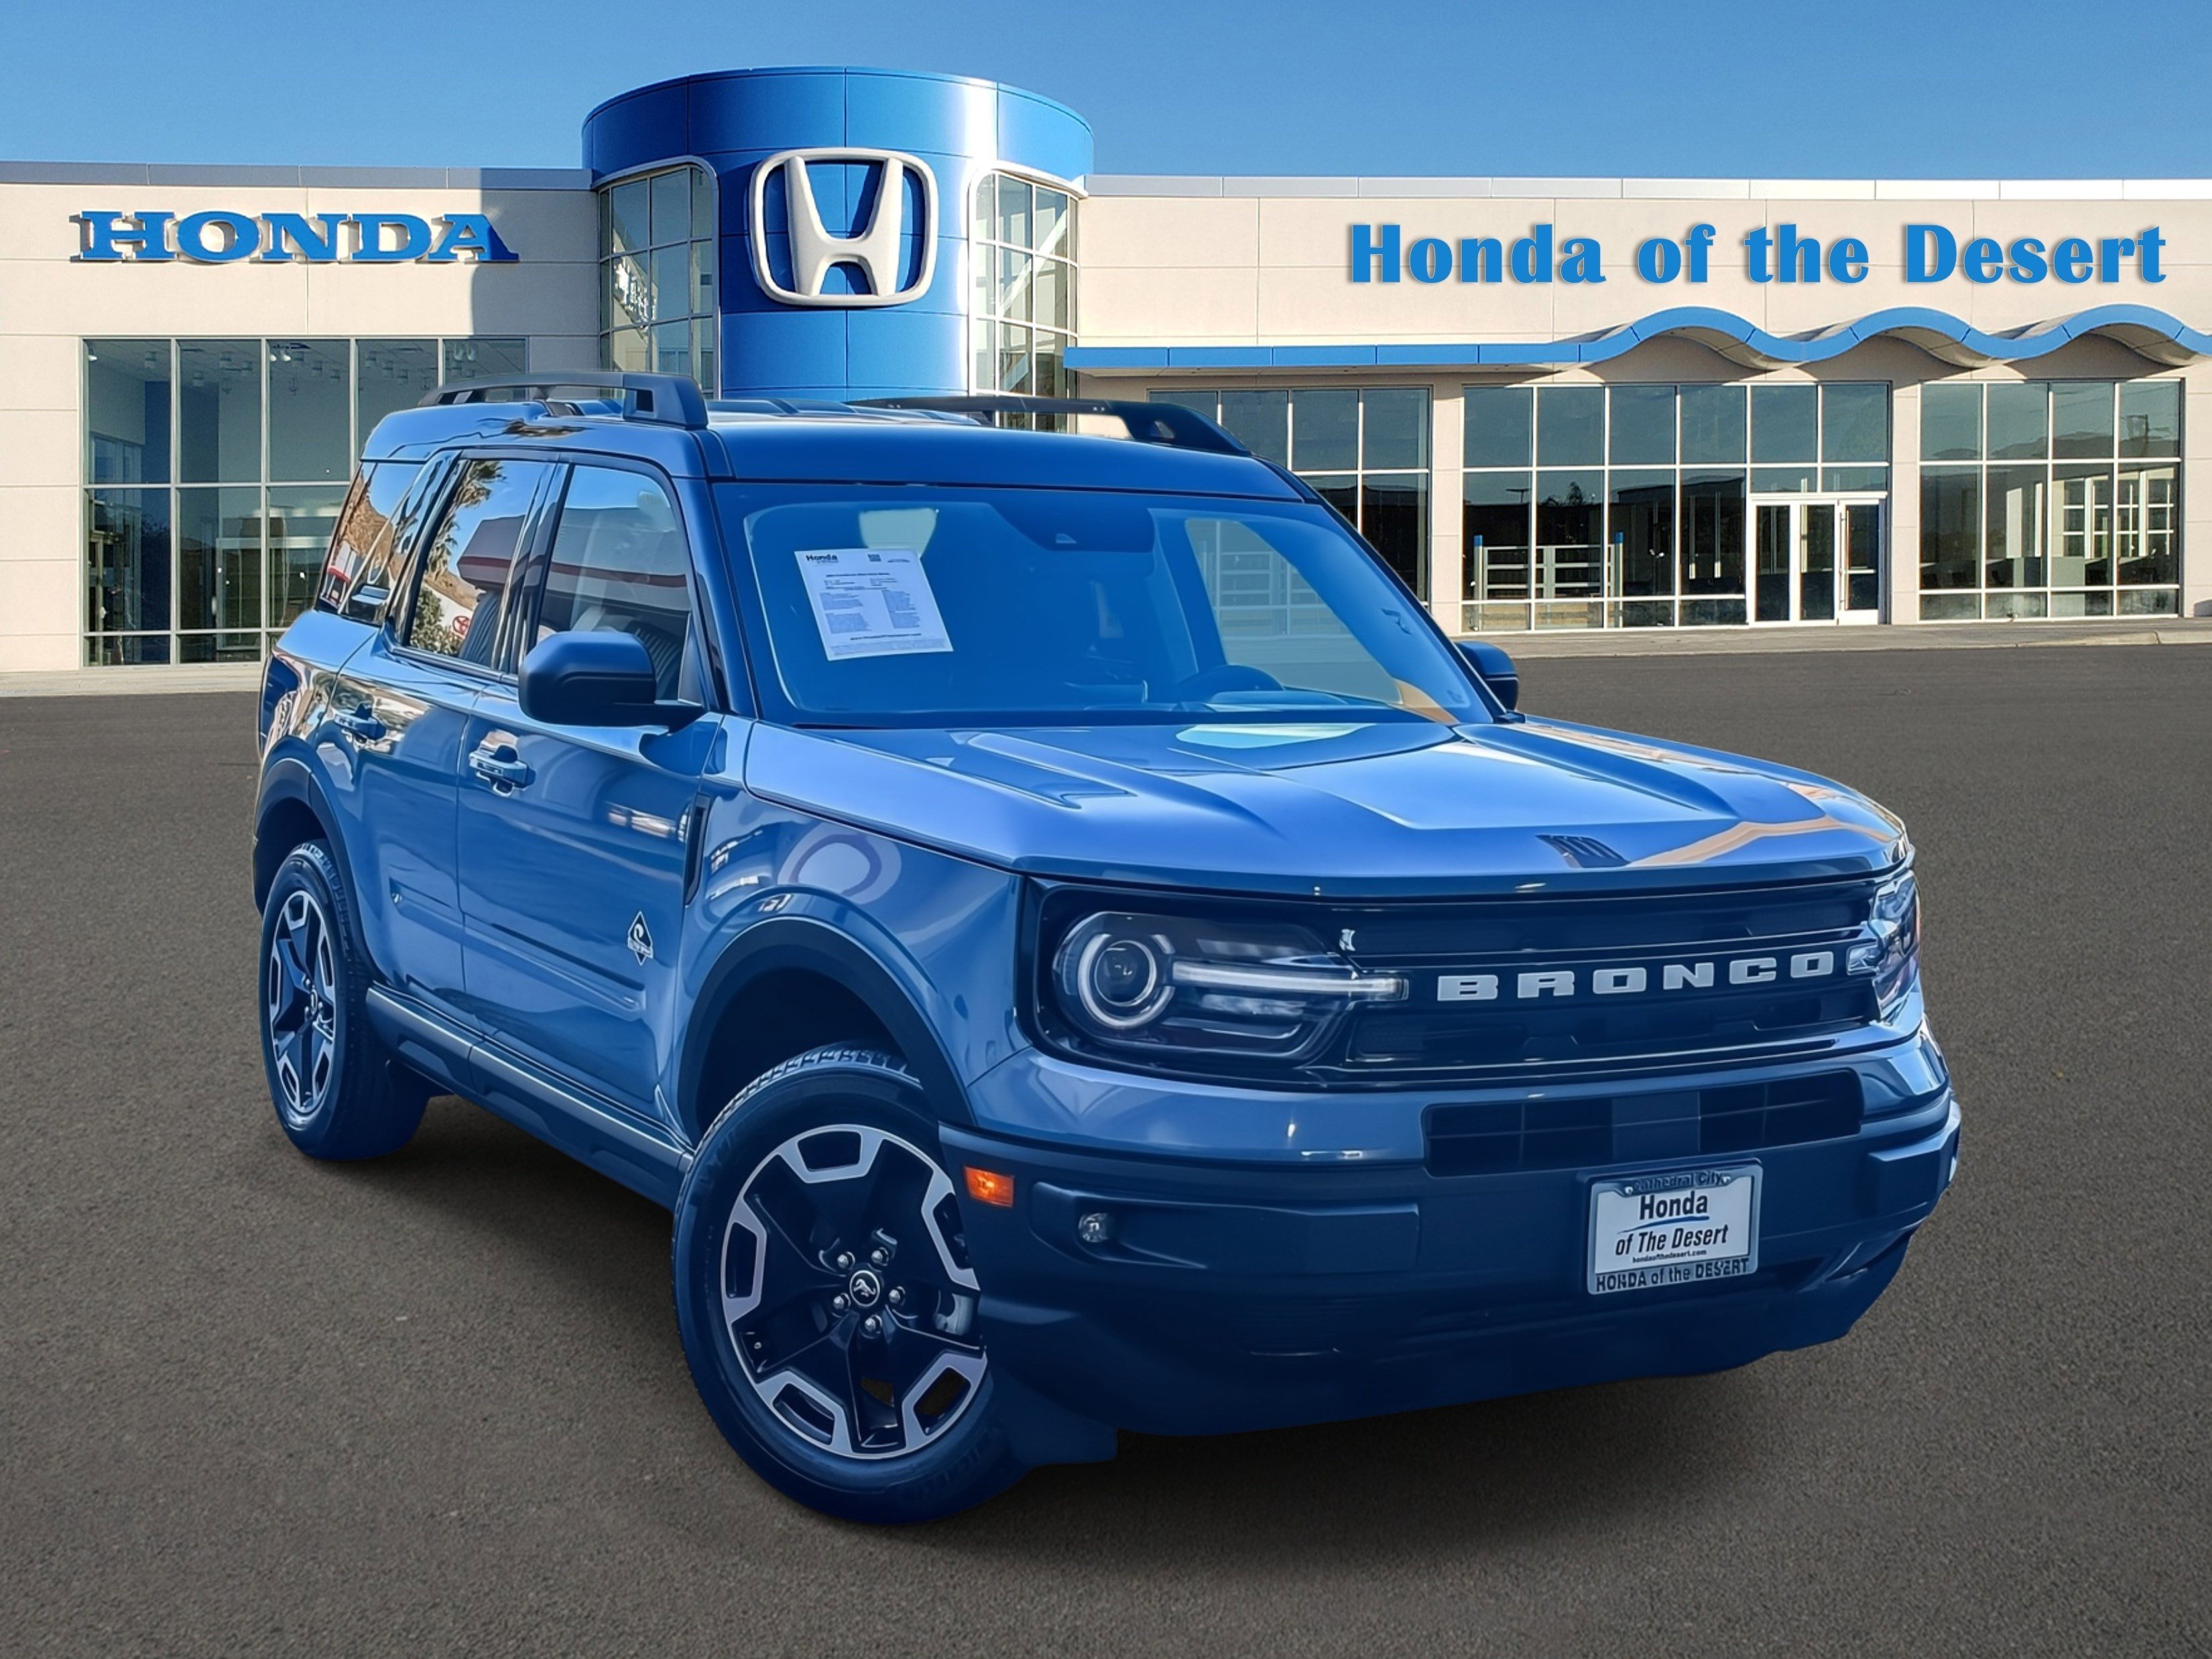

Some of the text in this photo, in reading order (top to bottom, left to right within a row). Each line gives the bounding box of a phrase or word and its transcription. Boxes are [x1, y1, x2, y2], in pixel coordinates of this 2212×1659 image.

[70, 210, 519, 262] HONDA
[1351, 223, 2166, 284] Honda of the Desert
[1436, 951, 1834, 1001] BRONCO
[1697, 1170, 1724, 1186] City
[1640, 1190, 1709, 1220] Honda
[1615, 1224, 1729, 1255] of The Desert
[1596, 1257, 1749, 1292] HONDA of the DESERT
